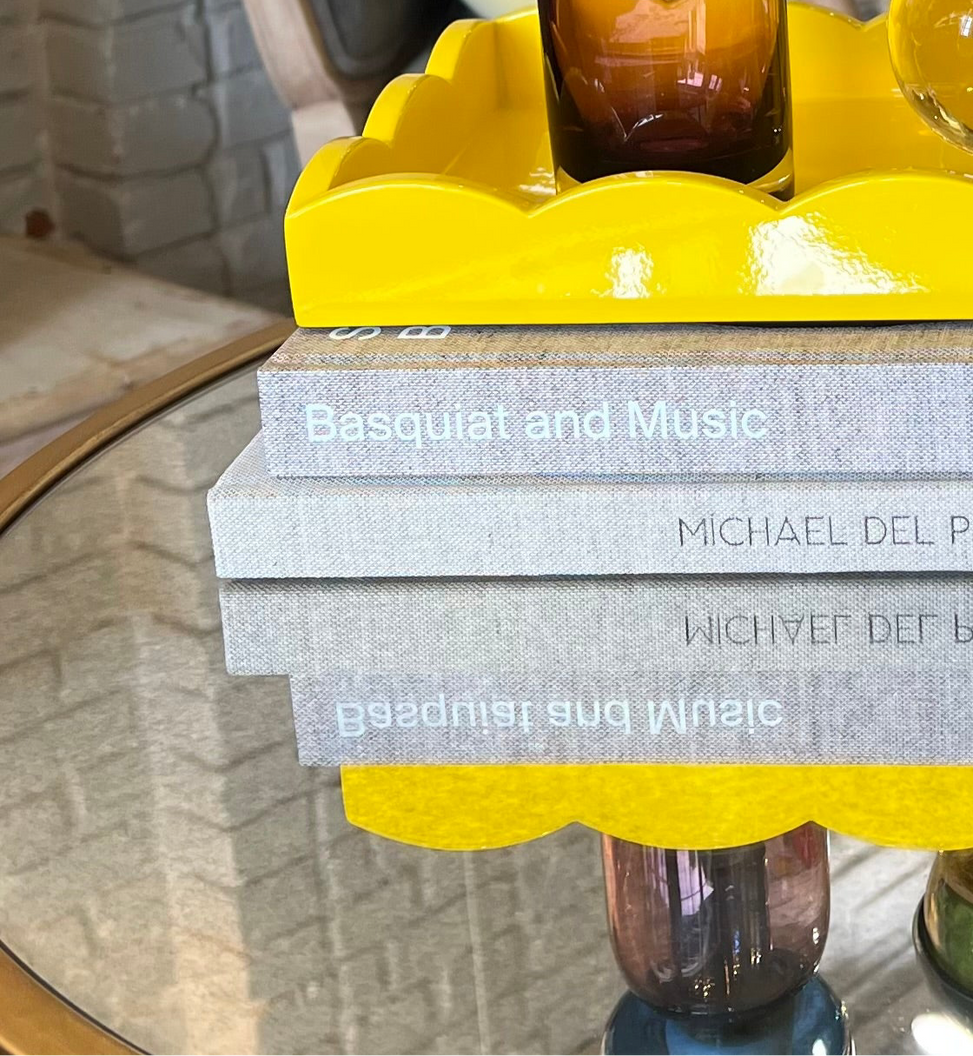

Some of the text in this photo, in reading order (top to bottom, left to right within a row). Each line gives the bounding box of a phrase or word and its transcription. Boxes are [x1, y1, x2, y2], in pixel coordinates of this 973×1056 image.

[305, 401, 768, 447] Basquiat and Music
[679, 514, 848, 546] MICHAEL
[864, 515, 935, 545] DEL
